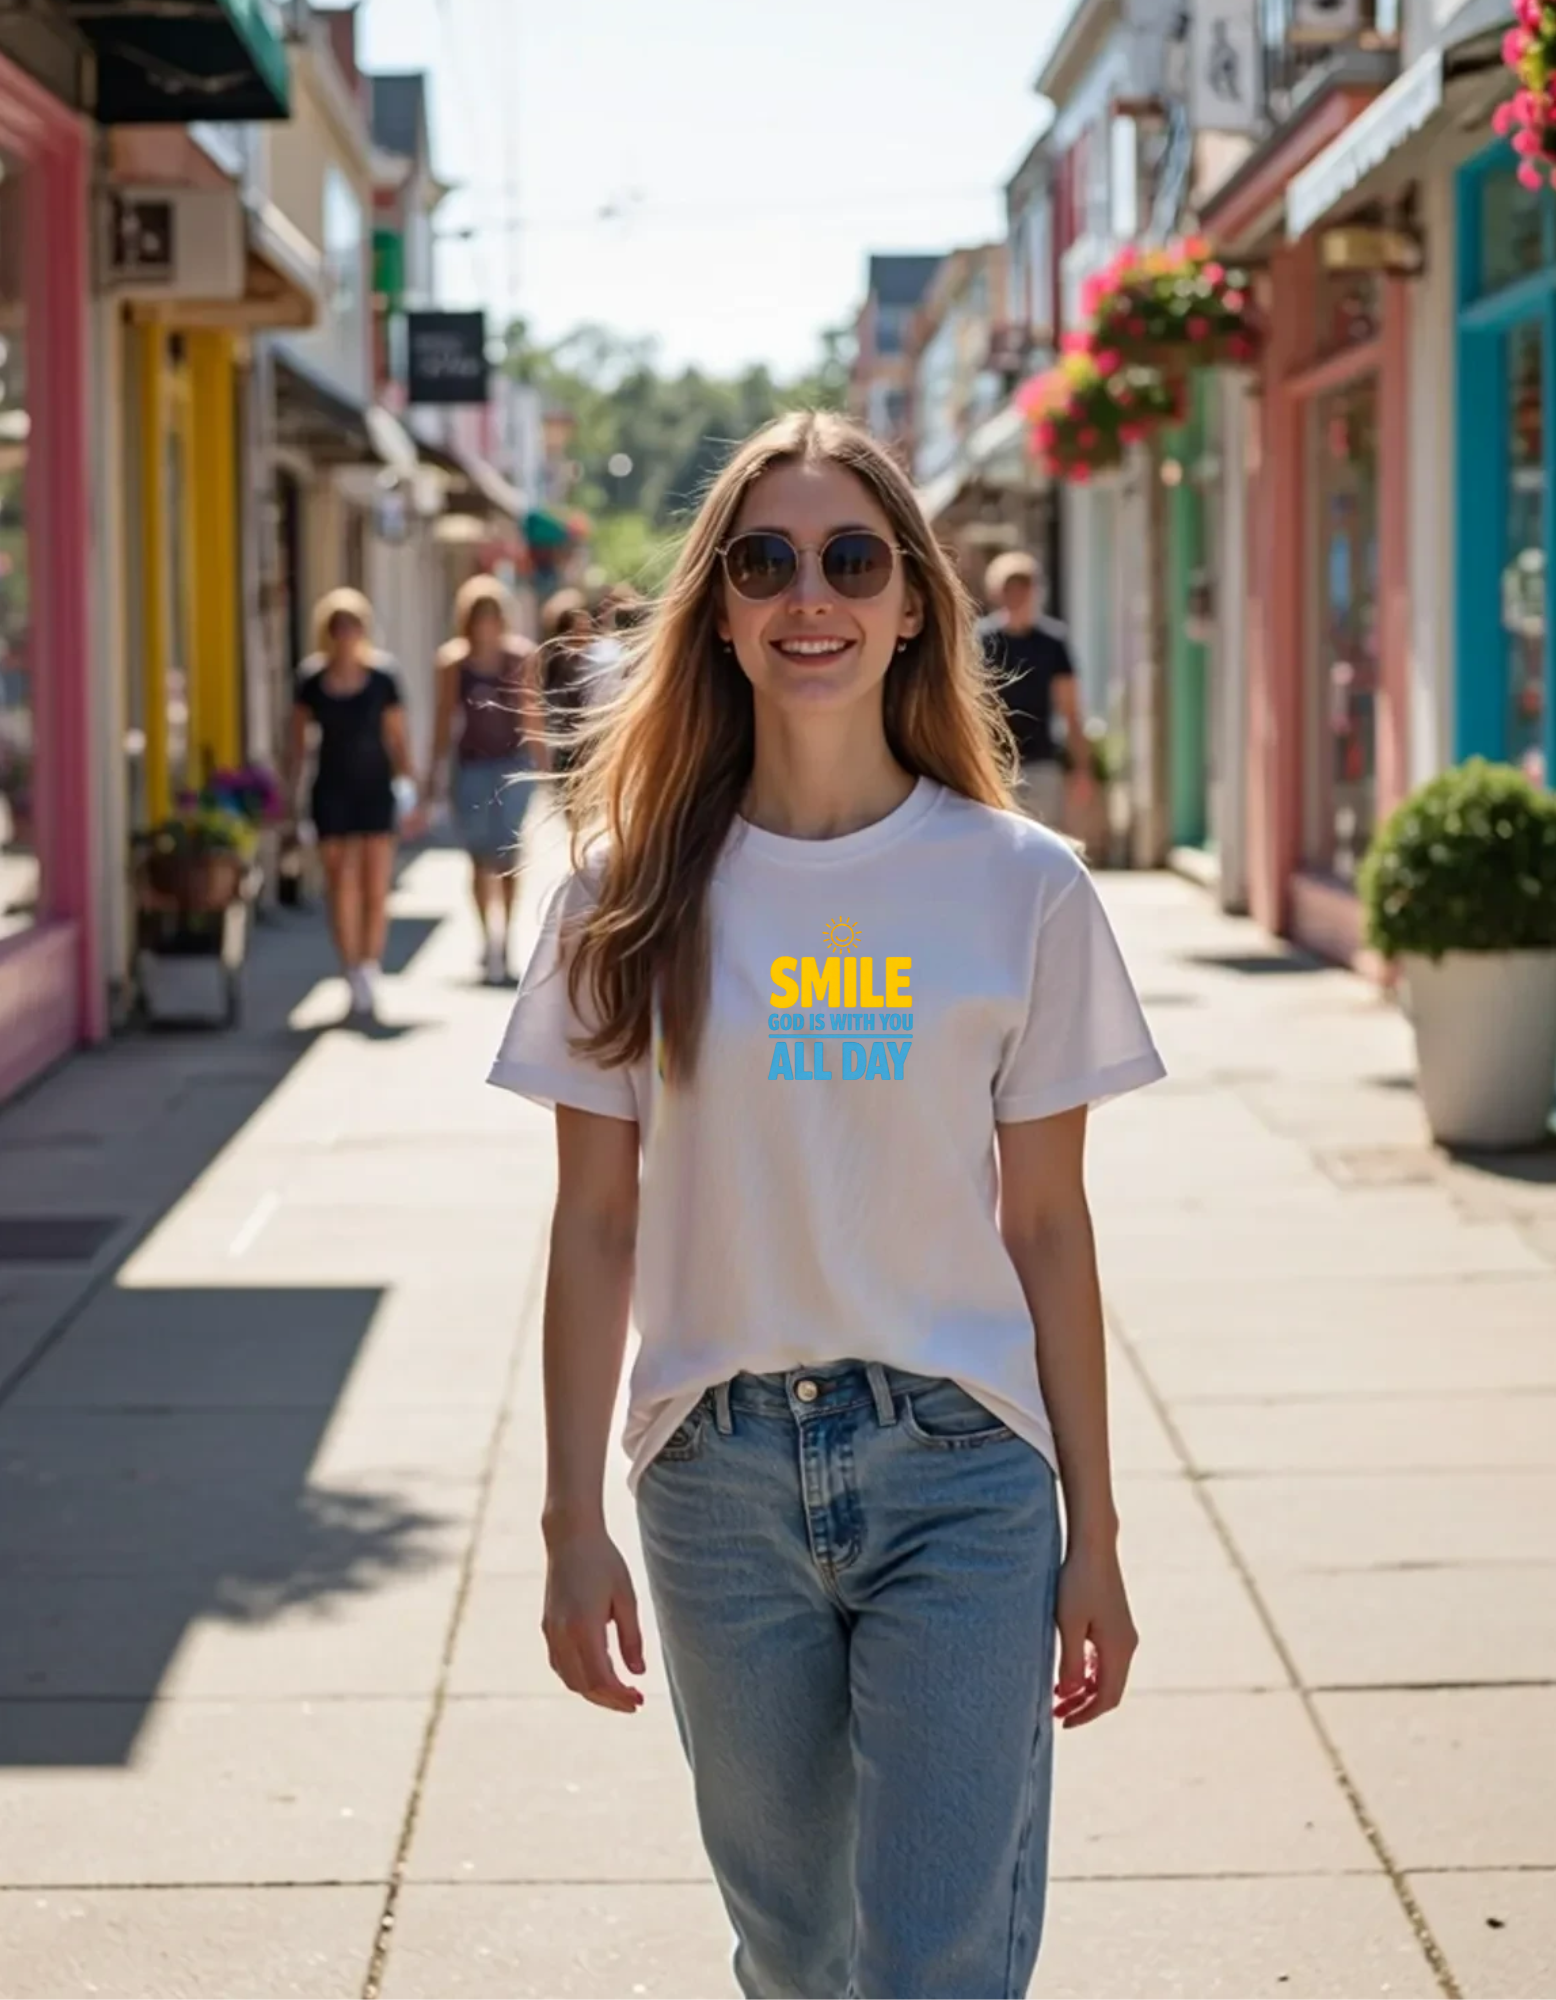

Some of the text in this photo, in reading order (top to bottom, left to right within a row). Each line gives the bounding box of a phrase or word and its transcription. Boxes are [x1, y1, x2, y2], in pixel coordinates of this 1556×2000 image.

[770, 956, 913, 1009] SMILE
[768, 1013, 914, 1031] GOD IS WITH YOU
[768, 1042, 913, 1081] ALL DAY
